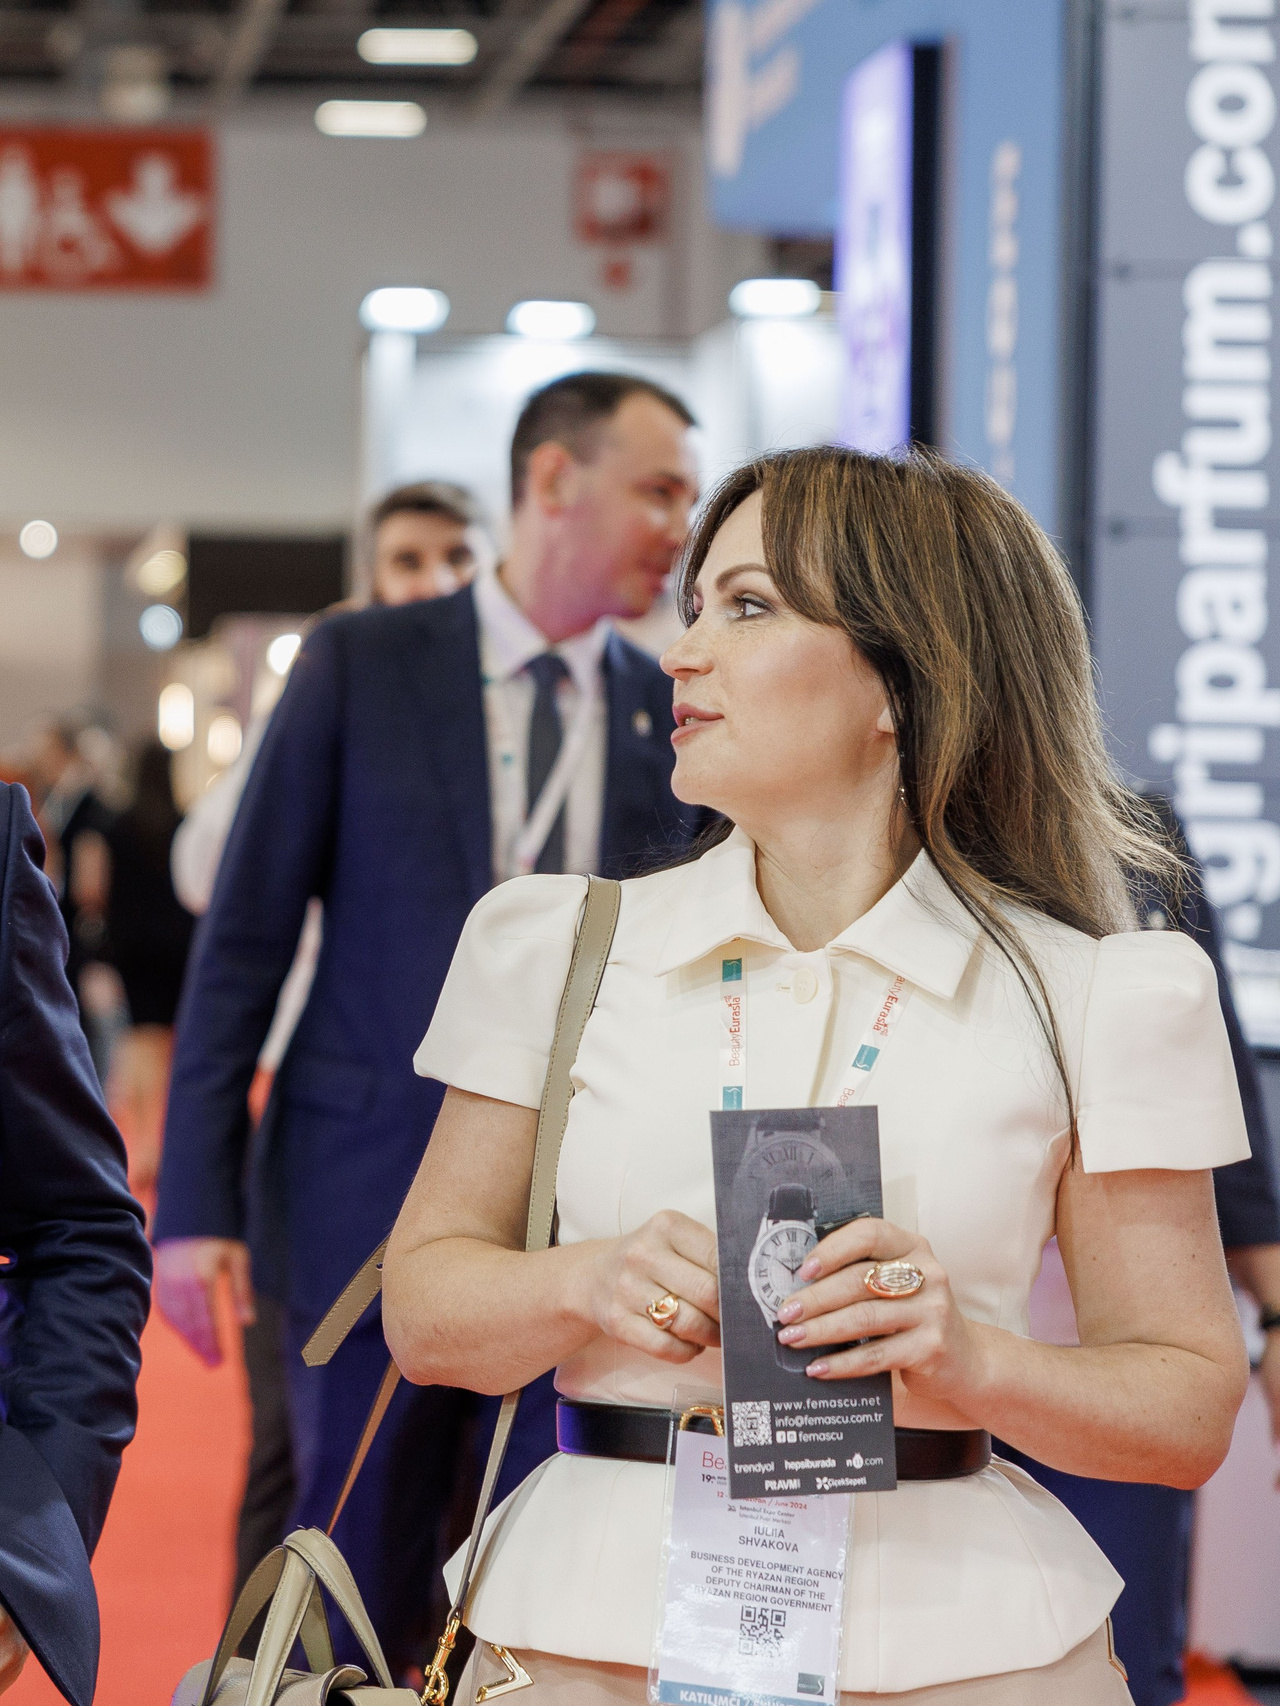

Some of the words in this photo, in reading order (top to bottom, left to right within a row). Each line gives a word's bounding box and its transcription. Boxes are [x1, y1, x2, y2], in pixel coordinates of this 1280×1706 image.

[773, 1396, 881, 1411] www.femascu.net
[774, 1412, 883, 1428] info@femascu.com.tr
[798, 1431, 844, 1443] femascu
[734, 1461, 775, 1474] trendyol
[784, 1457, 837, 1472] hepsiburada
[716, 1490, 724, 1498] 12
[790, 1501, 808, 1510] 2024
[738, 1535, 799, 1553] SHVAKOVA
[690, 1551, 735, 1565] BUSINESS
[737, 1557, 805, 1575] DEVELOPMENT
[806, 1567, 844, 1580] AGENCY
[711, 1565, 724, 1574] OF
[726, 1567, 744, 1577] THE
[745, 1570, 782, 1583] RYAZAN
[784, 1576, 819, 1588] REGION
[705, 1576, 741, 1588] DEPUTY
[743, 1581, 791, 1596] CHAIRMAN
[793, 1588, 806, 1598] OF
[808, 1590, 826, 1600] THE
[733, 1591, 768, 1604] REGION
[770, 1596, 833, 1613] GOVERNMENT
